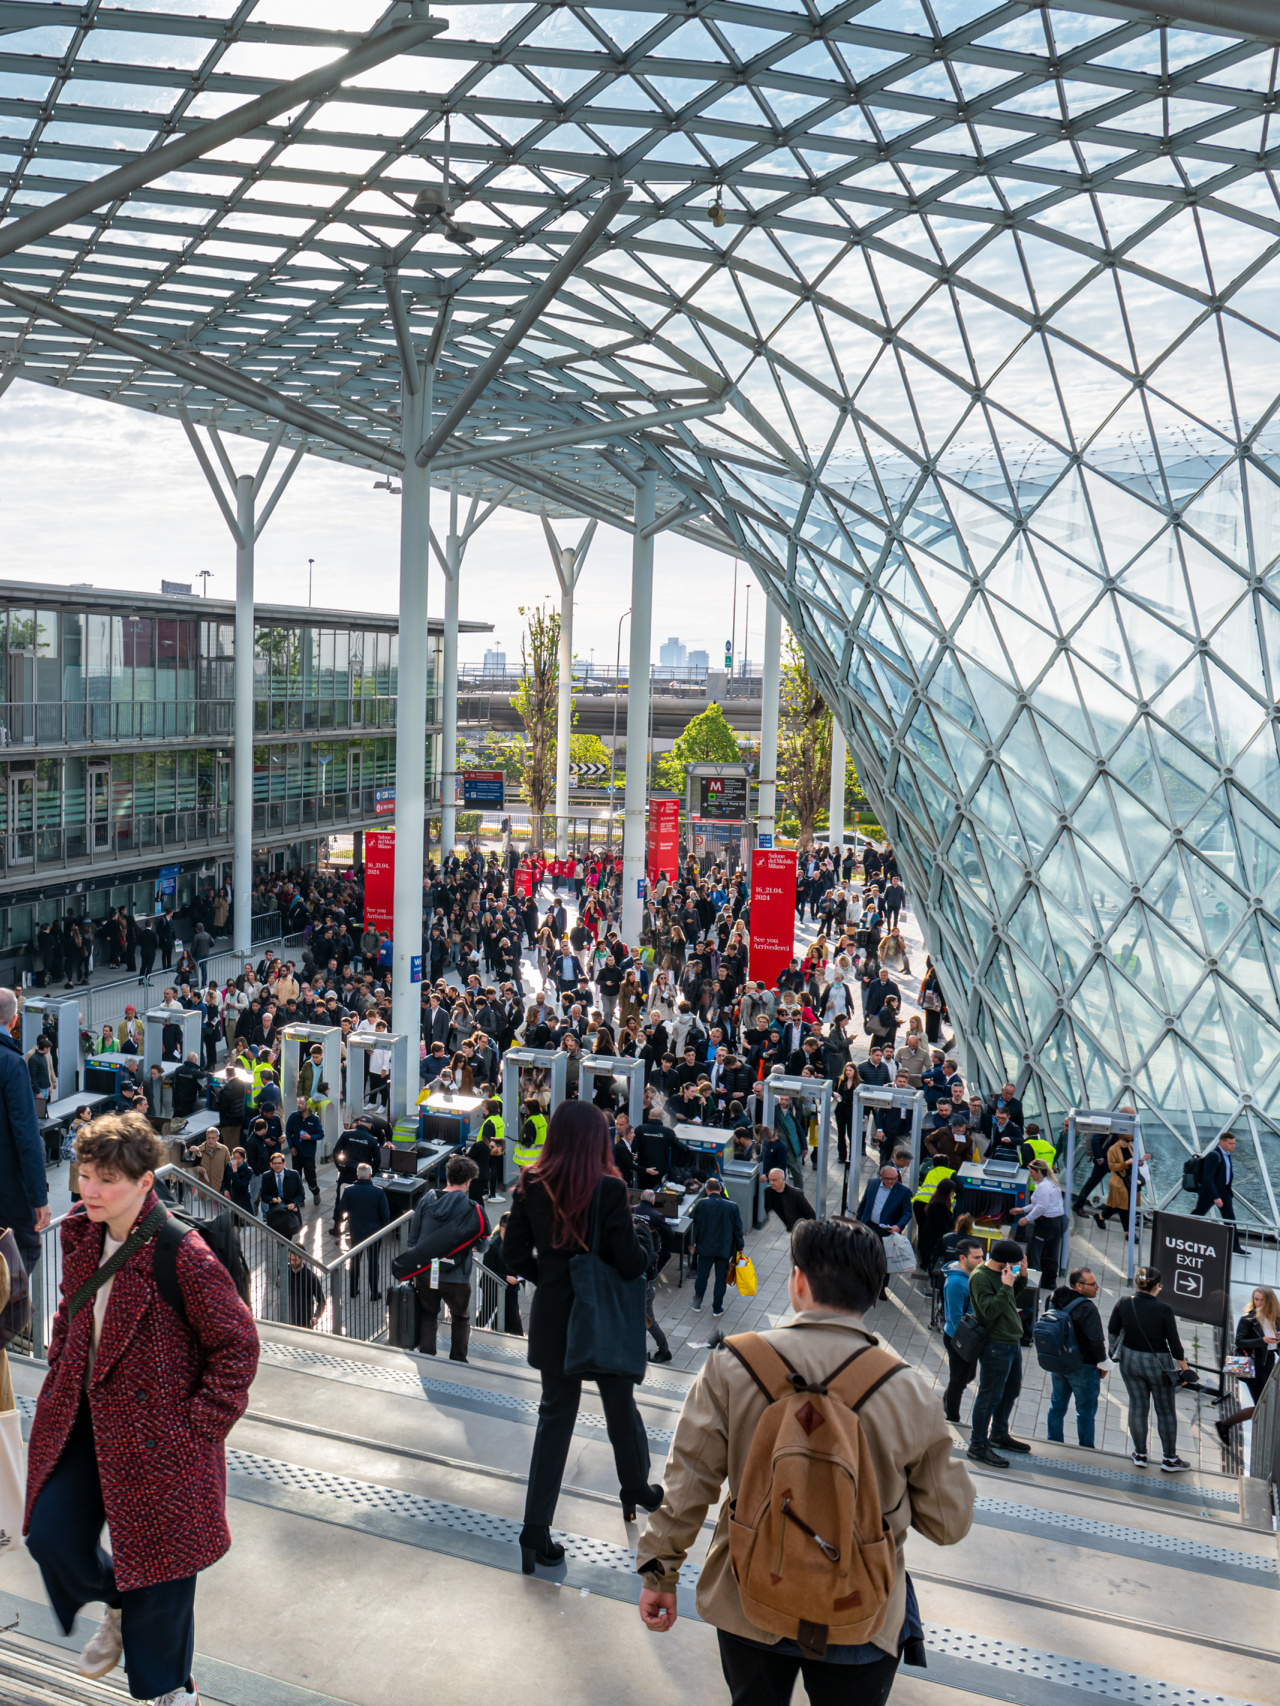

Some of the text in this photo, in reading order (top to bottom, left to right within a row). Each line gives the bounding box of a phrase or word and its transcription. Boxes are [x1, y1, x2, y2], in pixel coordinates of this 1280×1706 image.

[710, 781, 722, 791] M
[755, 886, 784, 894] 16_21.04.
[753, 943, 789, 951] Arrivederci
[1165, 1236, 1217, 1258] USCITA
[1176, 1254, 1204, 1269] EXIT
